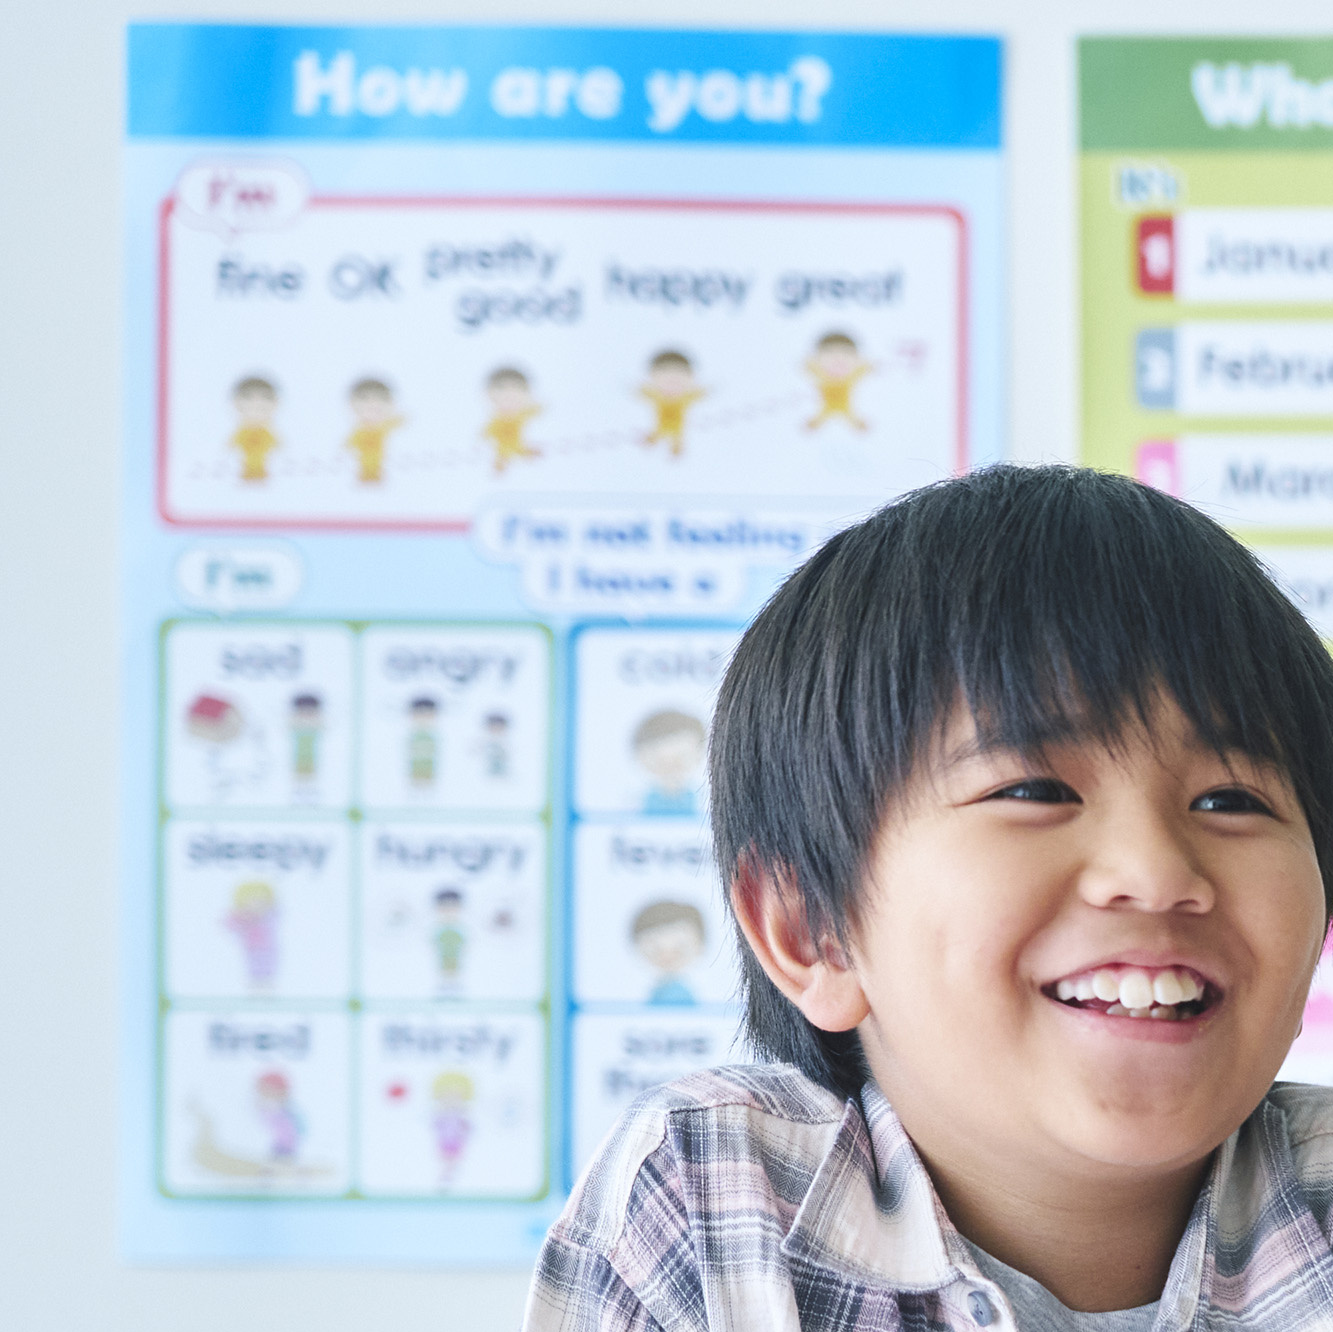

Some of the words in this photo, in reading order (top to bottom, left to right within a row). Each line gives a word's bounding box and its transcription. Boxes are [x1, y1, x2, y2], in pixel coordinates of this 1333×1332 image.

[293, 50, 468, 120] How
[492, 64, 624, 120] are
[645, 56, 835, 132] you?
[216, 253, 304, 298] fine
[329, 254, 403, 300] OK
[424, 237, 562, 283] pretty
[456, 286, 584, 330] good
[604, 263, 756, 312] happy
[775, 268, 906, 313] great
[586, 518, 650, 544] not
[219, 642, 304, 684] sad
[385, 645, 522, 693] angry
[187, 836, 332, 882] sleepy
[375, 836, 529, 882] hungry
